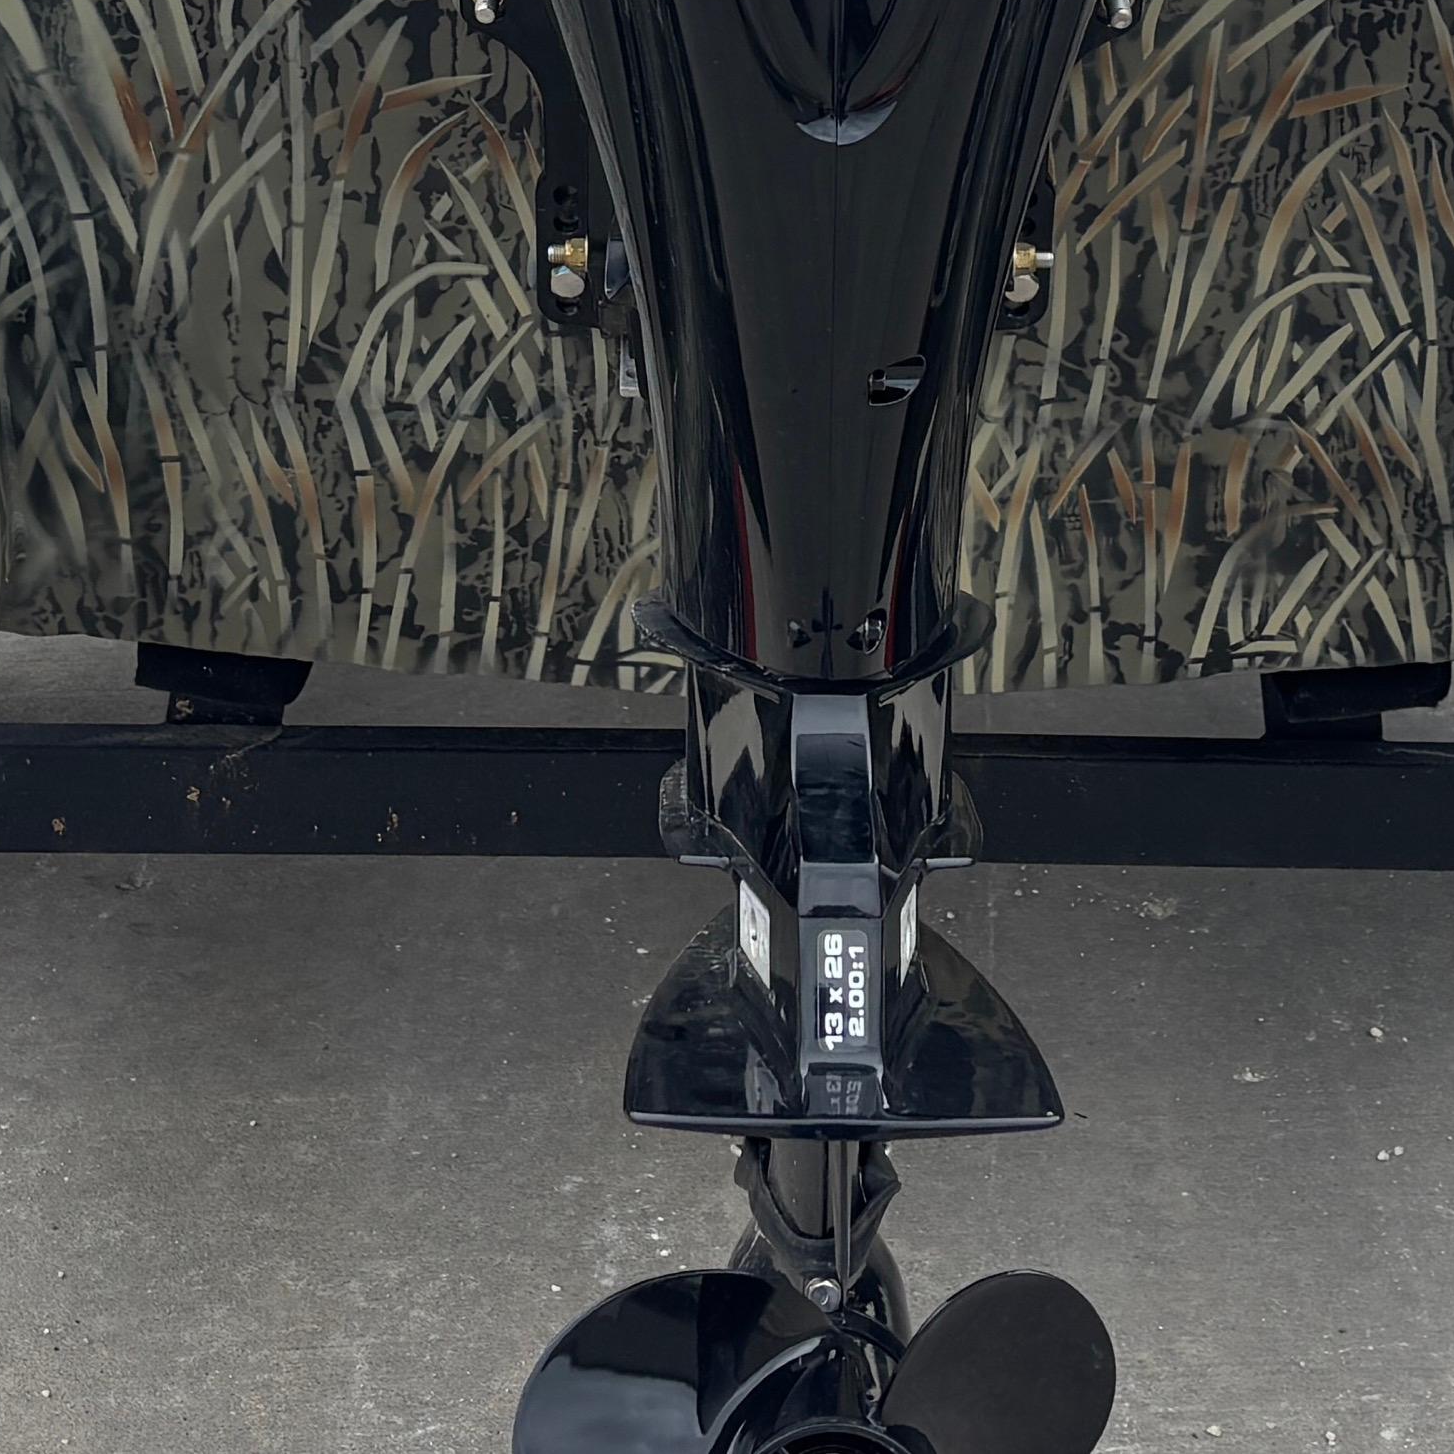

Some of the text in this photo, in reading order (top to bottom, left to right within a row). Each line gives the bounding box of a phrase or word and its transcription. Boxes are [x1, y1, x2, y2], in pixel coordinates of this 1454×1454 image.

[824, 933, 844, 1051] 13 x 26
[848, 946, 865, 1037] 2.00:1
